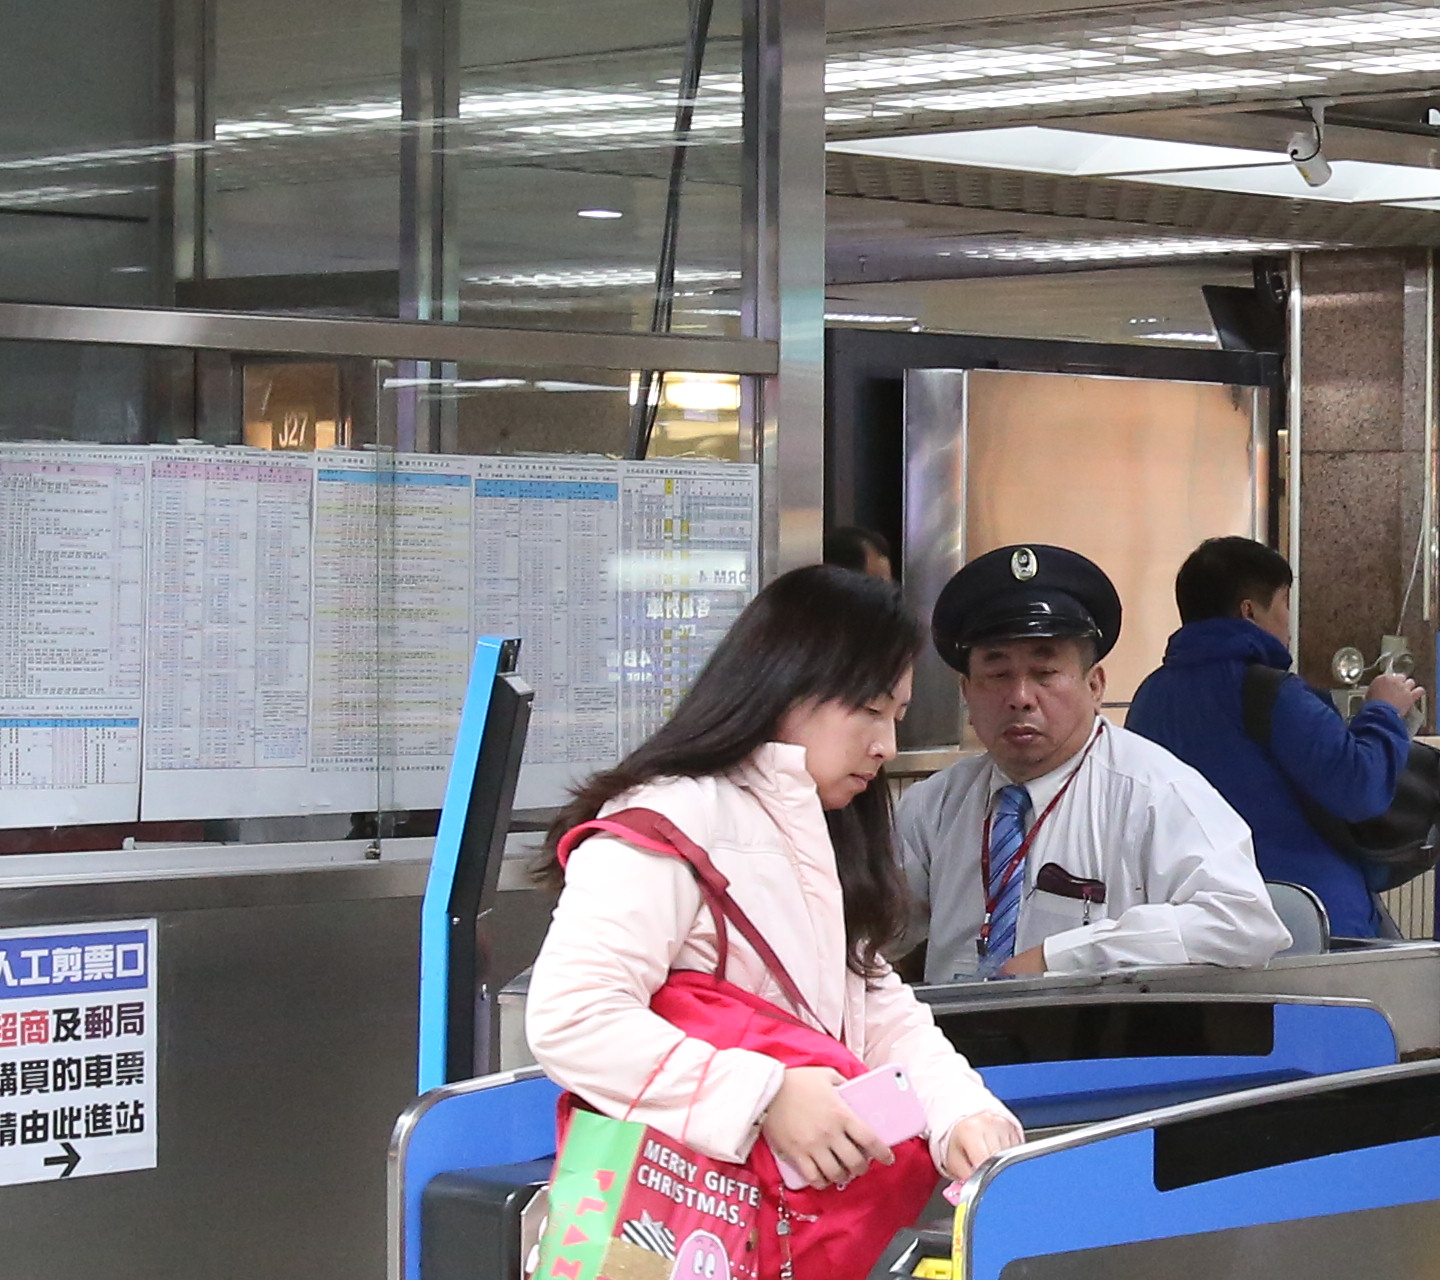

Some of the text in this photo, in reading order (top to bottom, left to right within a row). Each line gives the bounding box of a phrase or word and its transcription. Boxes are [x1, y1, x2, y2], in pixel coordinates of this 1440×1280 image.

[278, 412, 310, 447] J27
[638, 1165, 746, 1228] CHRISTMAS.
[643, 1139, 760, 1207] MERRY GIFTE
